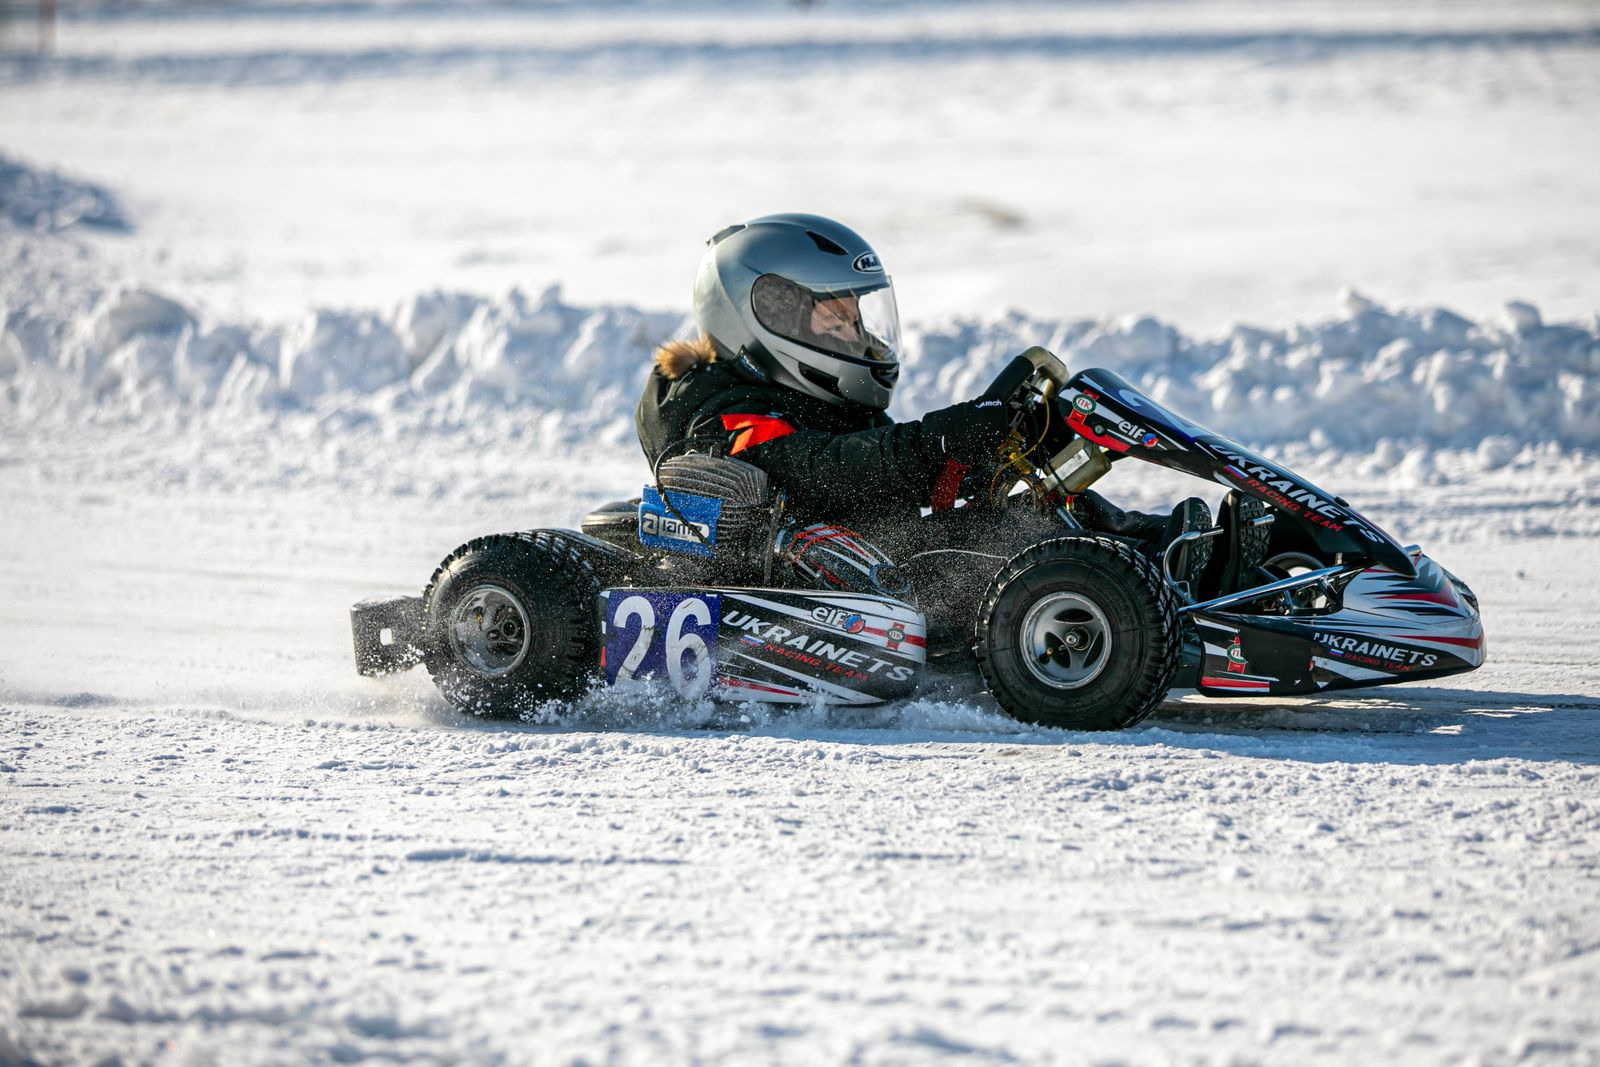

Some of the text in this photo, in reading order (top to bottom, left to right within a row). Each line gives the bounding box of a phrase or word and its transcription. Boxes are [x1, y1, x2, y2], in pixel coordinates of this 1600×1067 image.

[861, 256, 881, 270] HJ
[1118, 421, 1147, 439] elf
[1209, 444, 1385, 544] UKRAINETS
[1247, 479, 1344, 532] RACING TEAM
[811, 606, 848, 628] elf
[614, 595, 712, 701] 26
[722, 610, 915, 682] UKRAINETS
[763, 643, 870, 682] RACING TEAM
[1344, 651, 1381, 667] RACING
